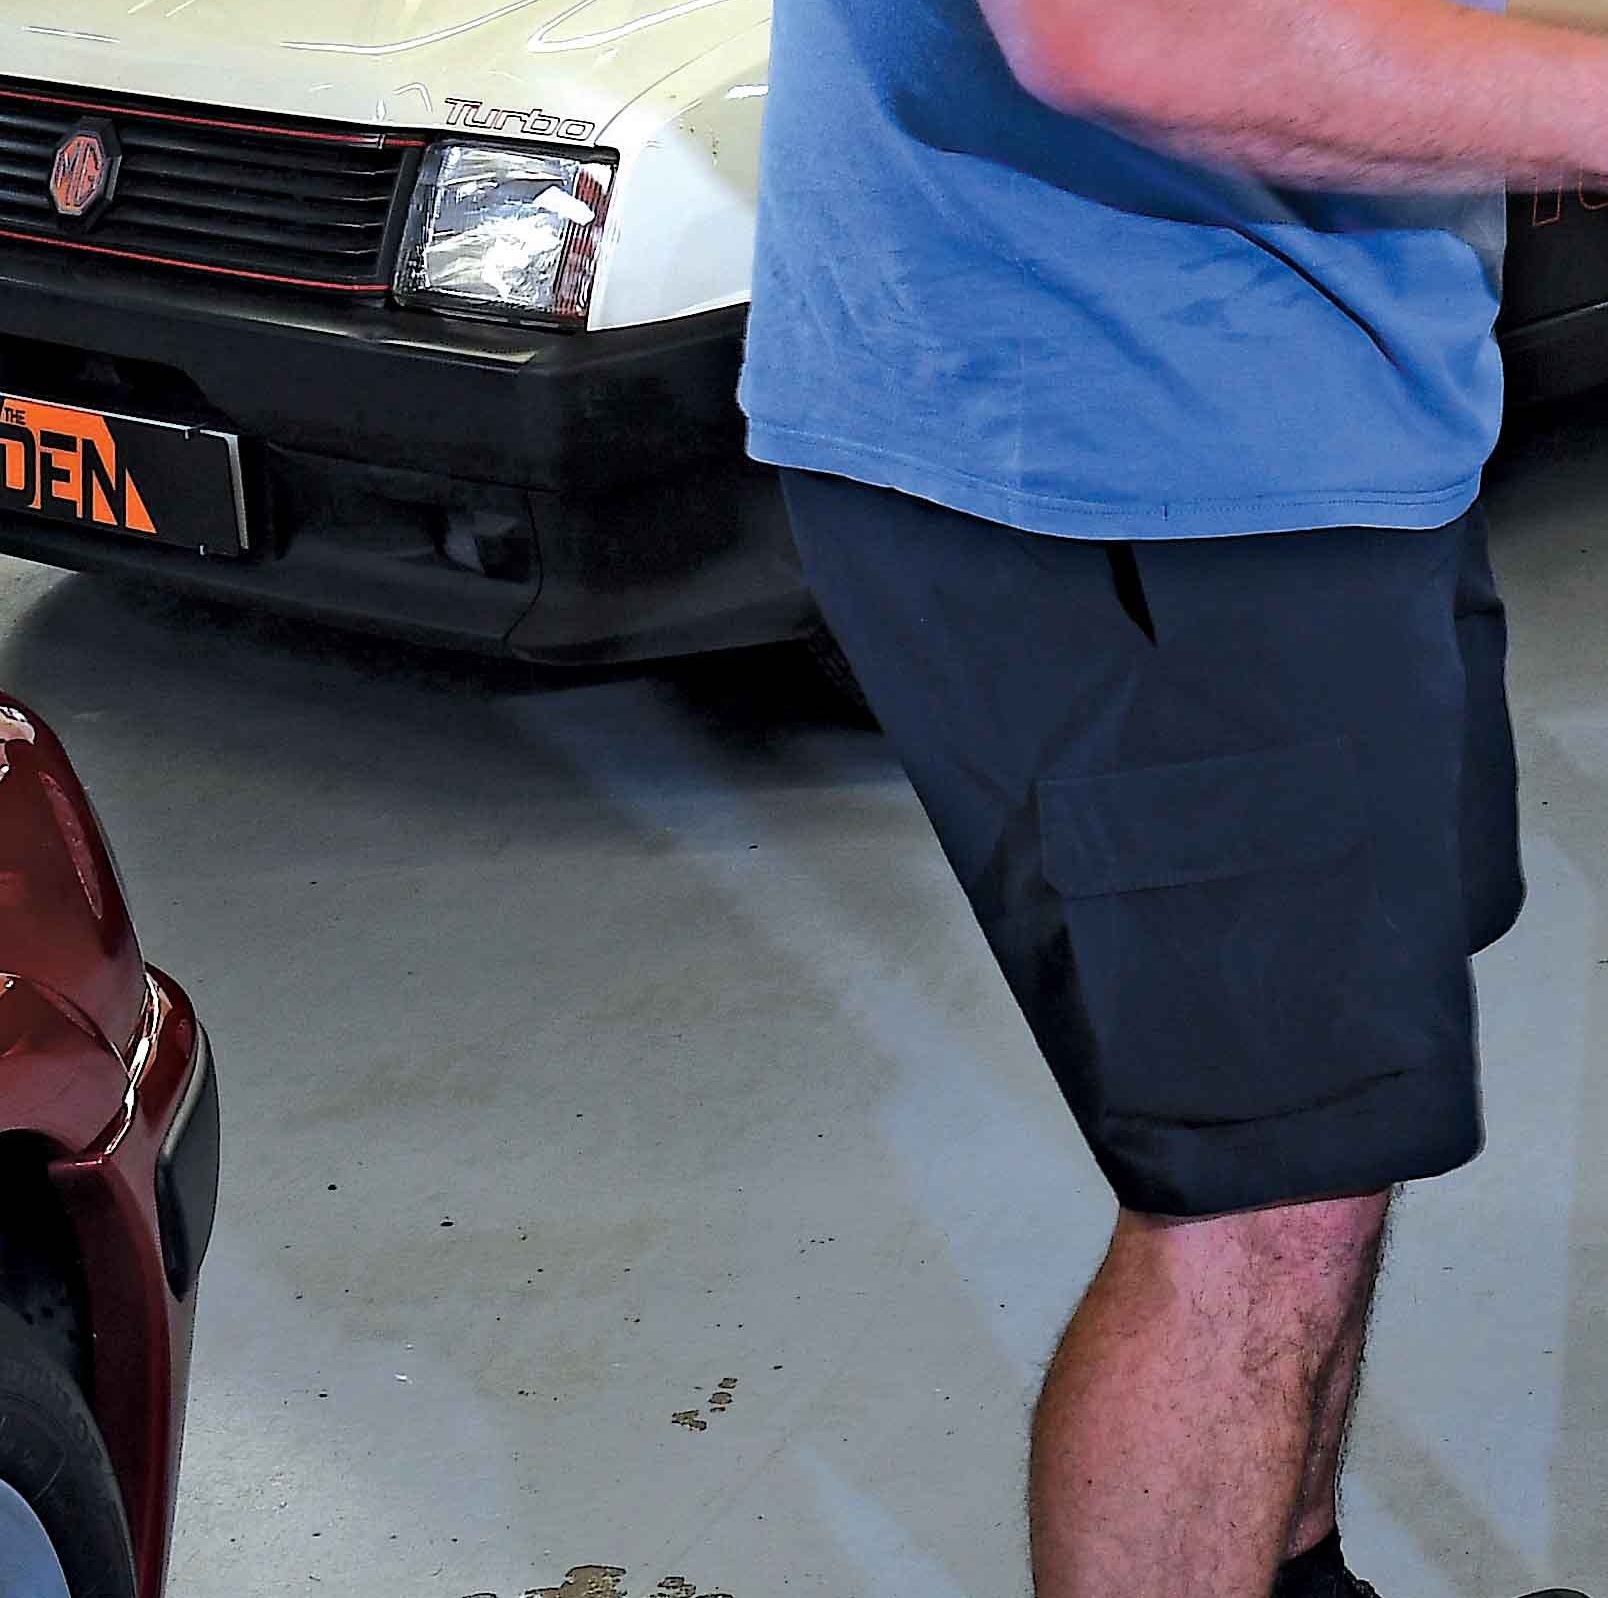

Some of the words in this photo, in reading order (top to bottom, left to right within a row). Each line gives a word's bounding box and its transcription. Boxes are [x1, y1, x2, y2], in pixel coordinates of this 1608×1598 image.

[444, 97, 596, 142] Turbo
[56, 142, 102, 207] MG
[5, 407, 26, 424] THE
[0, 421, 128, 530] DEN
